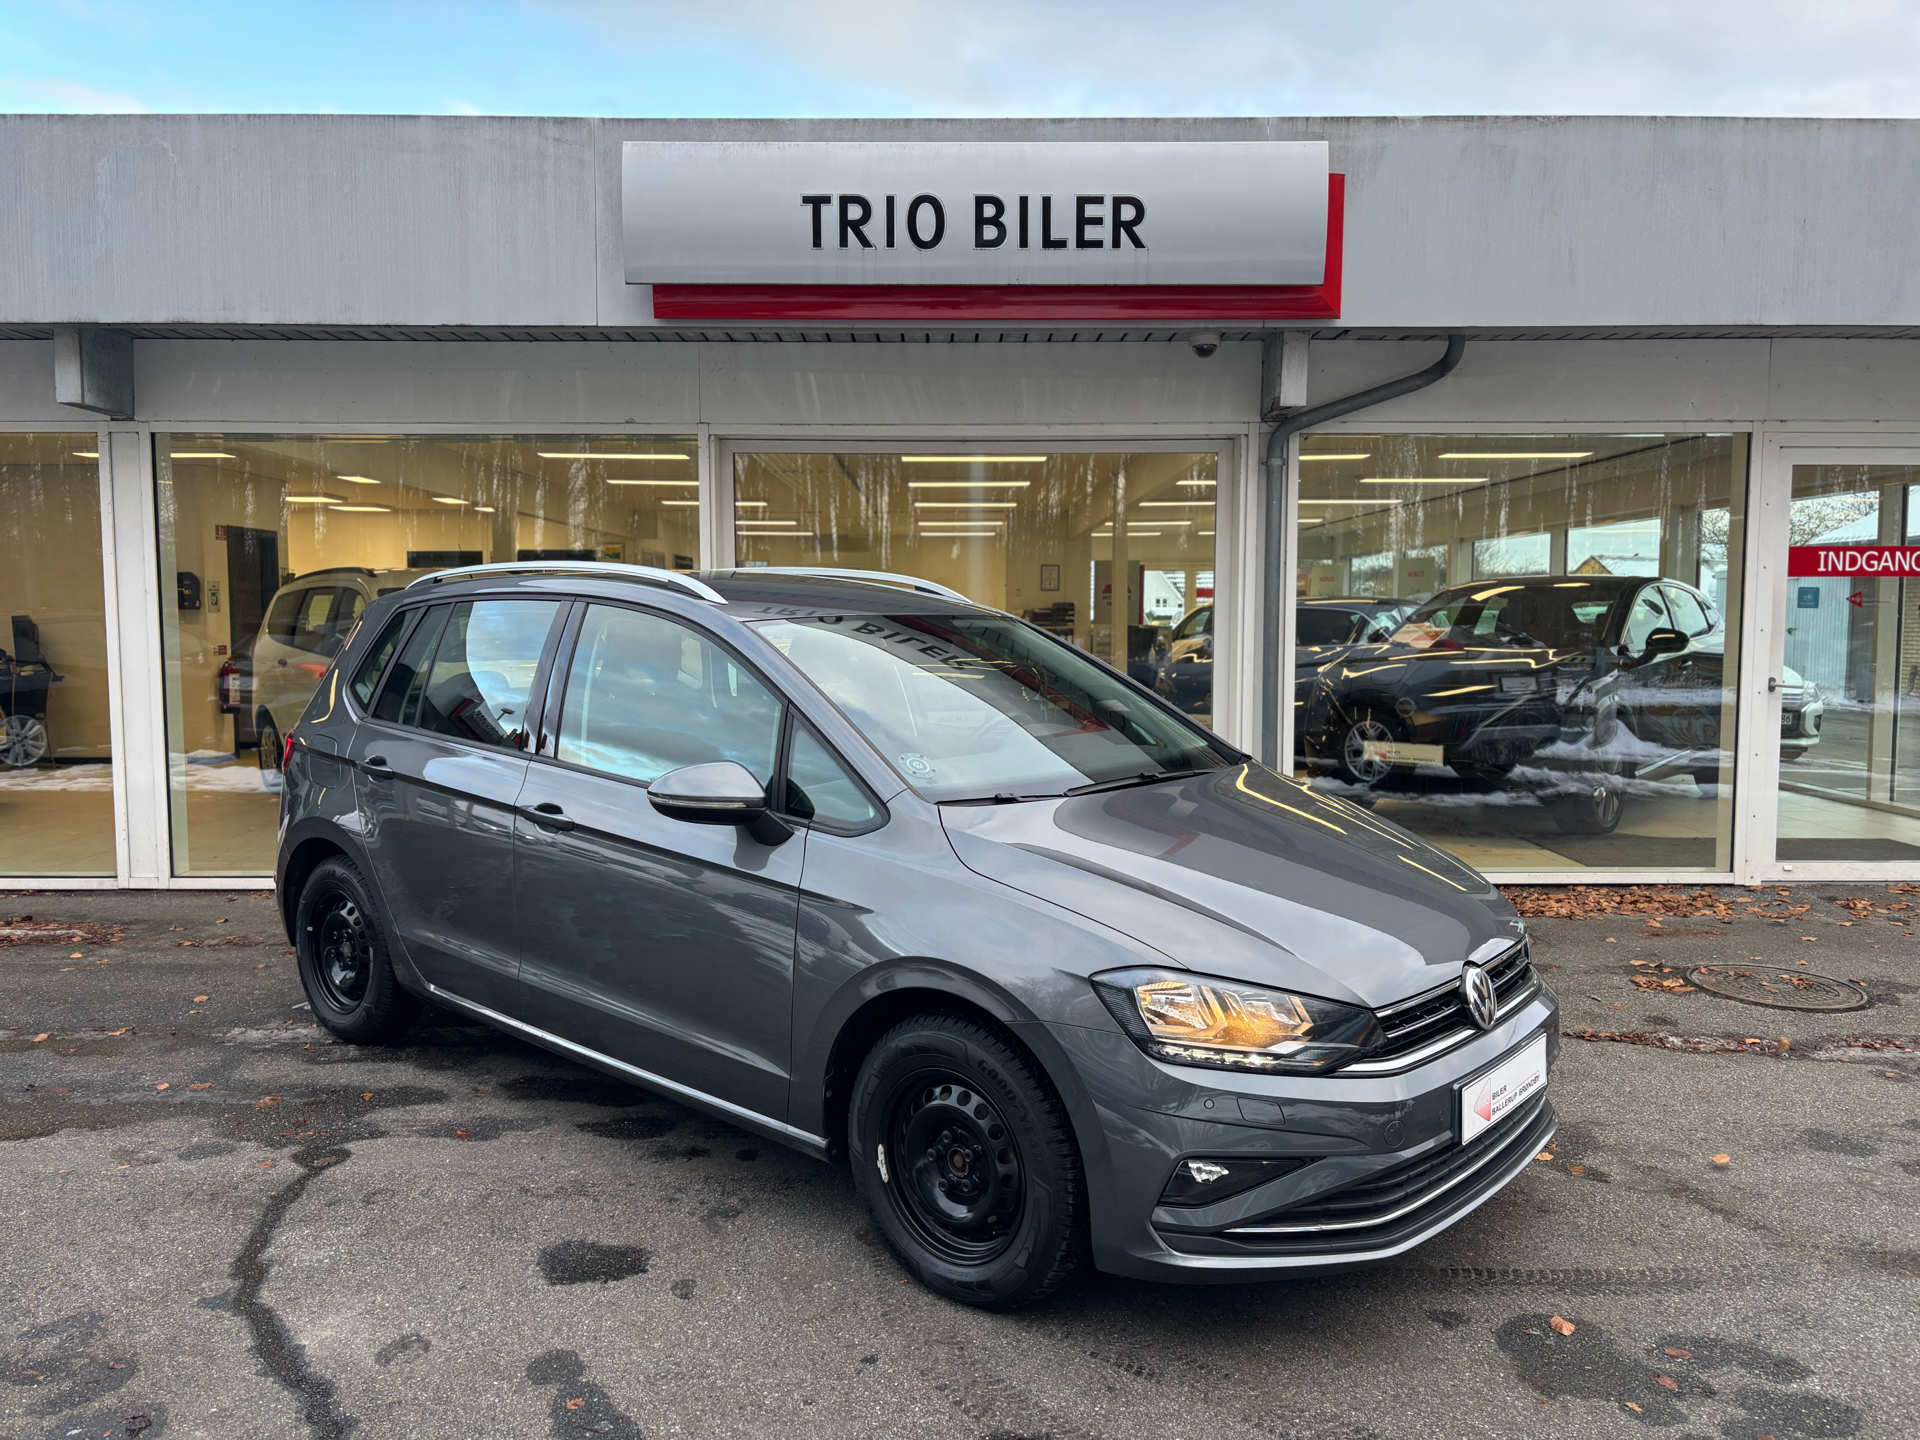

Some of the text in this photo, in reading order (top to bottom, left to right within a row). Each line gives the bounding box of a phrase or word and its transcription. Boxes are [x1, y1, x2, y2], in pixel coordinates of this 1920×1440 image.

[801, 193, 1149, 251] TRIO BILER
[1491, 1085, 1507, 1100] BILER
[1491, 1092, 1518, 1115] BALLERUP
[977, 1059, 1044, 1167] GOODYEAR
